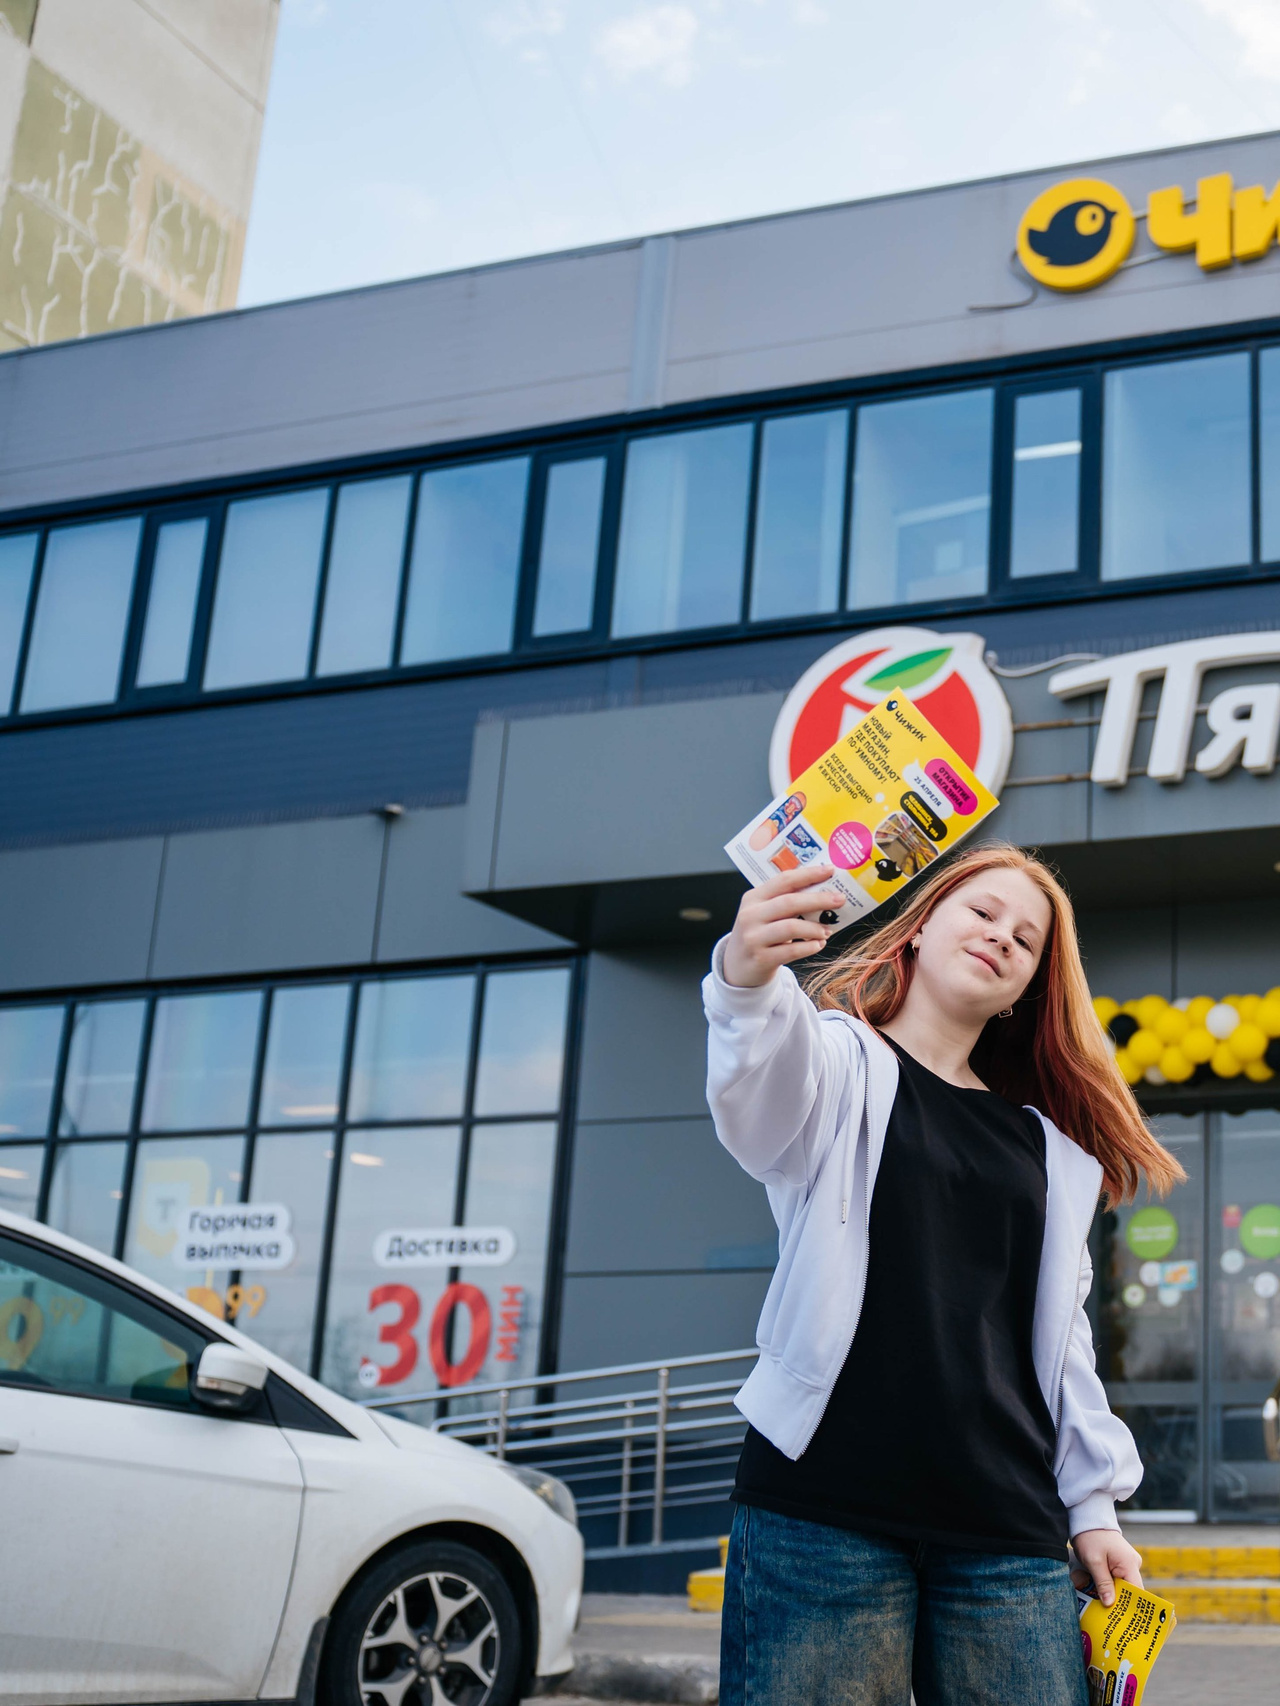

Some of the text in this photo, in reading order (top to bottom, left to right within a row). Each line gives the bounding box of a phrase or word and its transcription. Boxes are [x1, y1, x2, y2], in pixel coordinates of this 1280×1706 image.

[862, 722, 891, 760] МАГАЗИН,
[869, 715, 893, 741] НОВЫЙ
[847, 736, 888, 785] ПО-УМНОМУ!
[854, 729, 901, 783] ГДЕ ПОКУПАЮТ
[821, 768, 841, 793] ВКУСНО
[824, 759, 858, 800] КАЧЕСТВЕННО
[830, 753, 848, 775] ВСЕГДА
[845, 772, 873, 804] ВЫГОДНО
[920, 783, 942, 807] АПРЕЛЯ
[931, 772, 964, 808] МАГАЗИНА
[938, 767, 971, 802] ОТКРЫТИЕ
[227, 1283, 267, 1319] 99
[360, 1282, 492, 1387] 30
[1102, 1591, 1133, 1649] ВСЕГДА ВЫГОДНО
[1103, 1589, 1130, 1636] КАЧЕСТВЕННО
[1107, 1594, 1124, 1620] ВКУСНО
[1114, 1596, 1143, 1651] ПО-УМНОМУ!
[1131, 1601, 1151, 1641] МАГАЗИН,
[1143, 1603, 1156, 1635] НОВЫЙ
[1117, 1615, 1142, 1661] ПОКУПАЮТ
